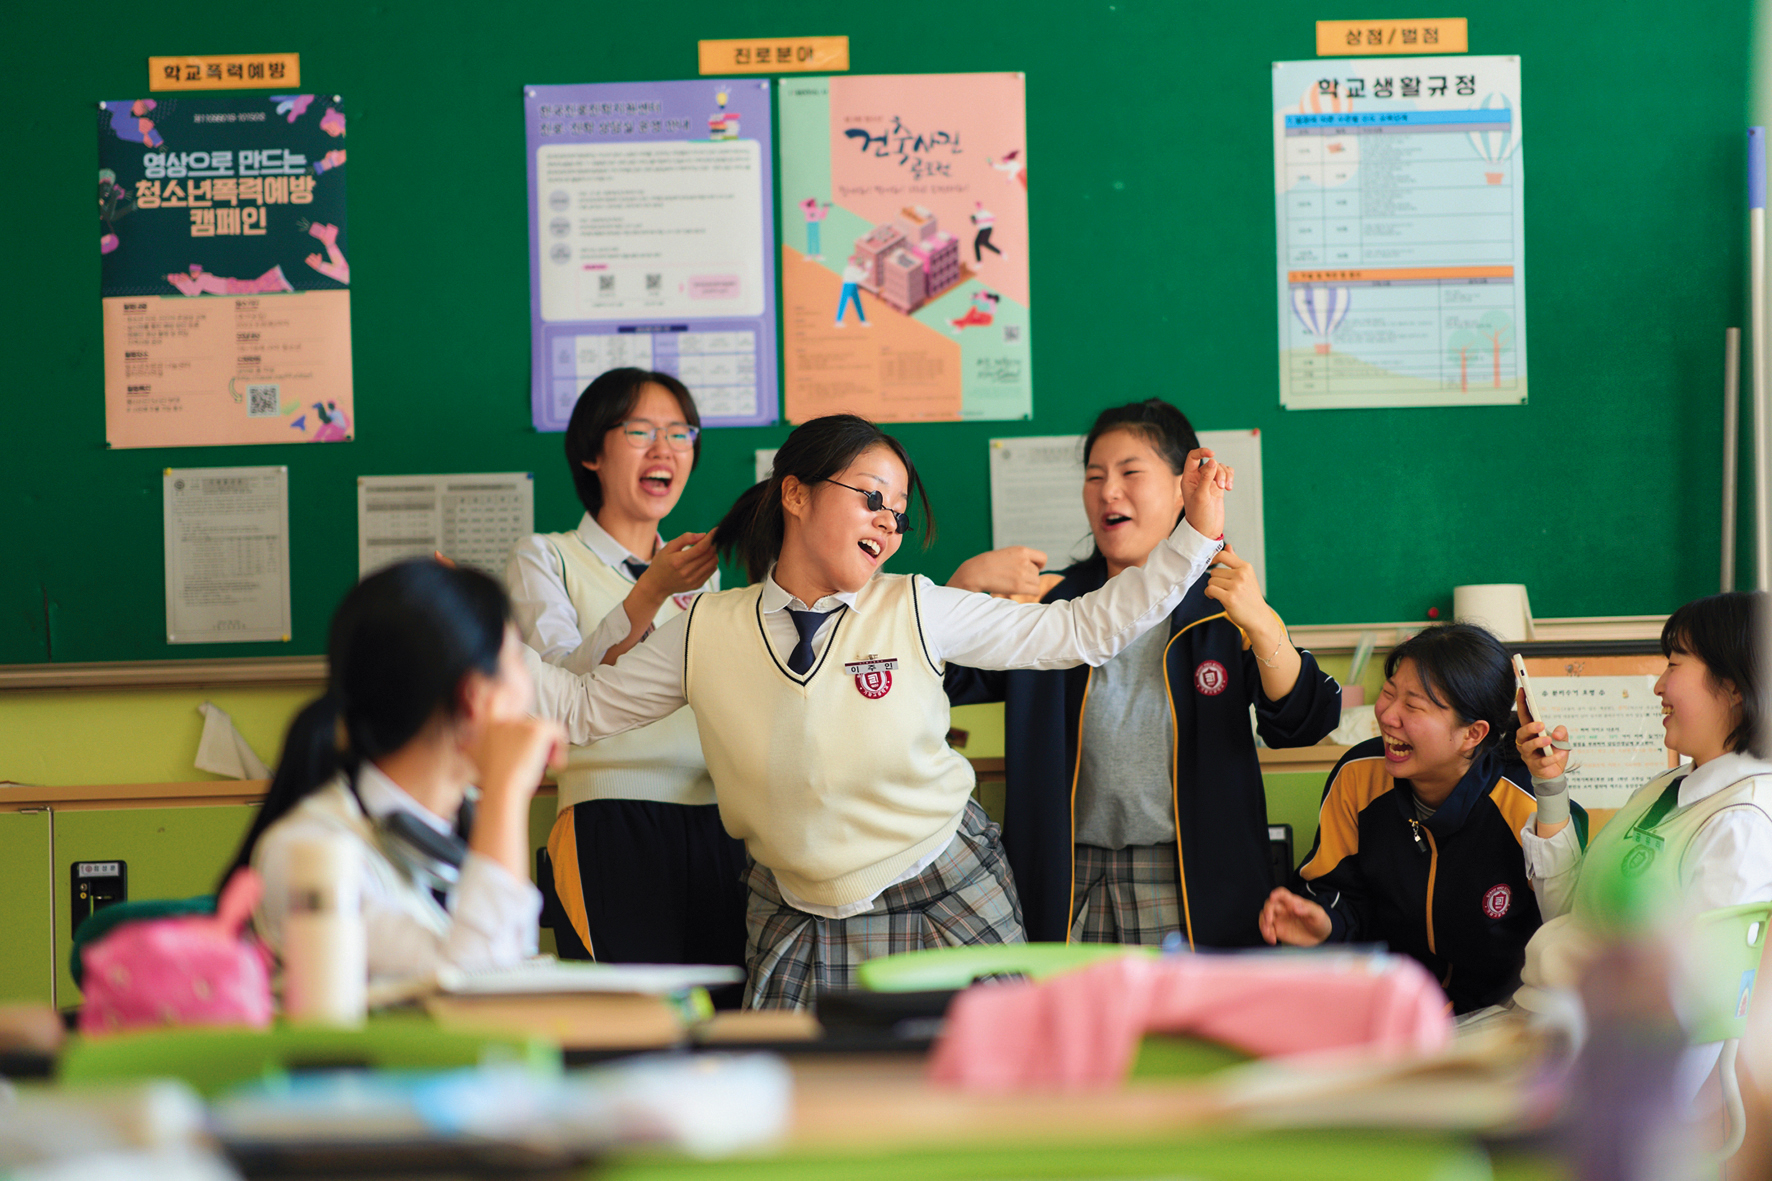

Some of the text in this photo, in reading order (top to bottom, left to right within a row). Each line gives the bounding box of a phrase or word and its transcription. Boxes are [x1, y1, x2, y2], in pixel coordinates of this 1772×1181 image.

[1345, 27, 1440, 46] 상점/벌점
[164, 62, 286, 82] 학교폭력예방
[1318, 74, 1477, 99] 학교생활규정
[143, 149, 307, 178] 영상으로 만드는
[135, 175, 316, 209] 청소년폭력예방
[189, 207, 267, 238] 캠페인
[850, 662, 893, 674] 이주인
